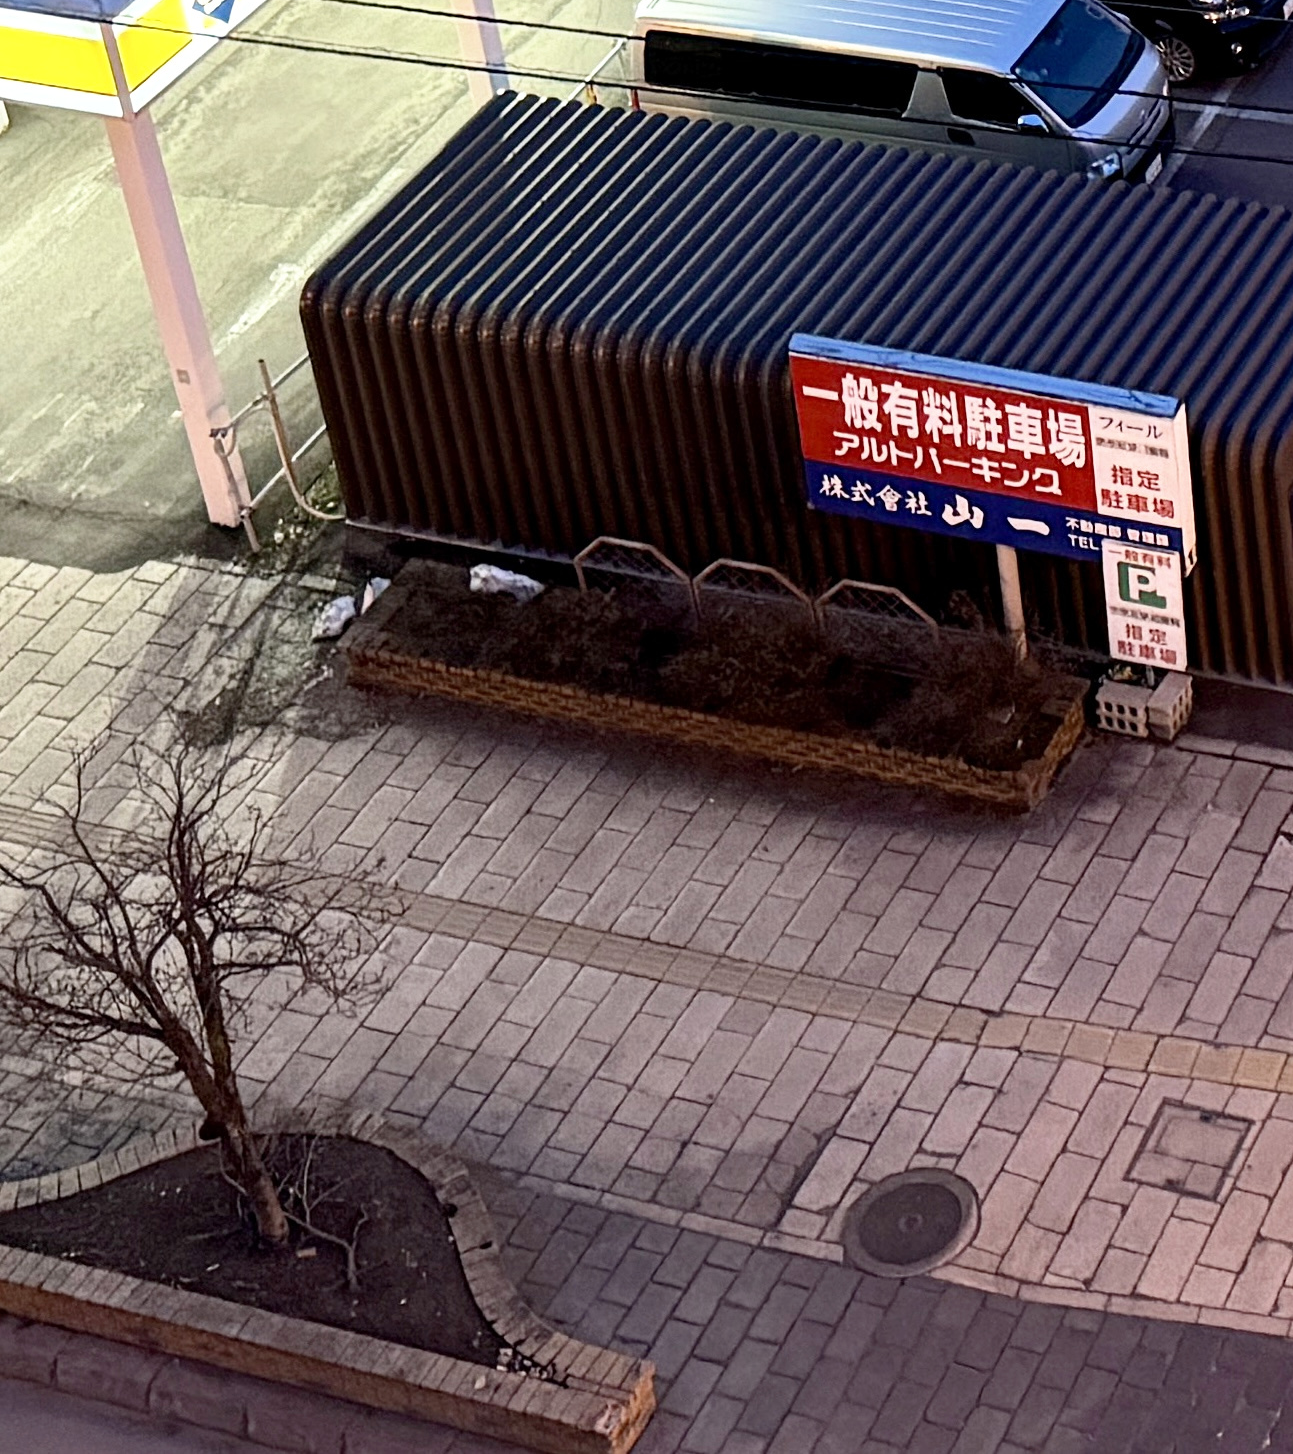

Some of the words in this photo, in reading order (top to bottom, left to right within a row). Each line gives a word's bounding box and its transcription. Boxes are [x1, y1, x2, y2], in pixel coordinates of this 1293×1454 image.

[802, 372, 1086, 469] 一般有料駐車場
[1098, 416, 1163, 439] フィール
[832, 430, 1063, 496] アルトパーキング
[1111, 464, 1161, 492] 指定
[819, 474, 932, 516] 株式會社
[941, 494, 1051, 536] 山一
[1101, 488, 1175, 519] 駐車場
[1067, 533, 1100, 551] TEL
[1108, 549, 1172, 569] 一般有料
